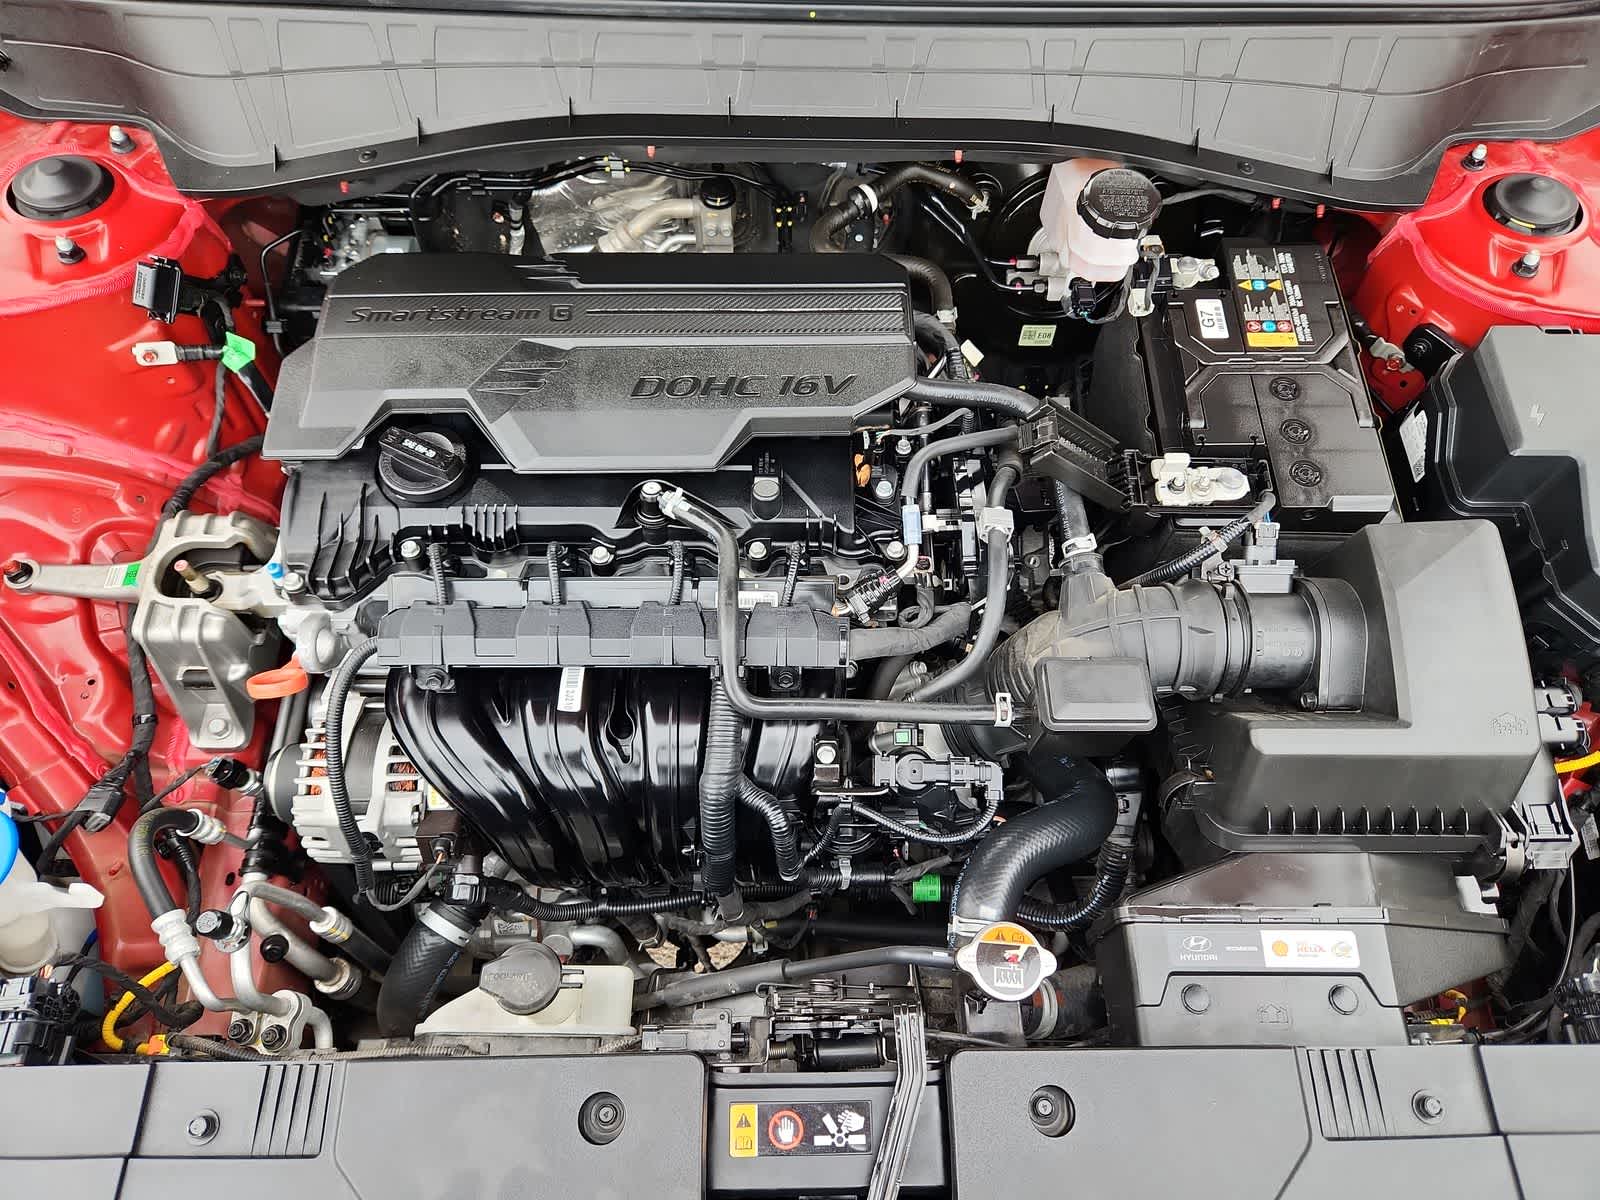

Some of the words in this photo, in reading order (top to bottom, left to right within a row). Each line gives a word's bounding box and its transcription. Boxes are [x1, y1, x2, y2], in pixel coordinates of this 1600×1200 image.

[345, 306, 542, 323] Smartstream
[551, 304, 573, 322] G
[1200, 310, 1216, 328] G7
[630, 374, 768, 398] DOHC
[778, 374, 857, 398] 16V
[401, 438, 418, 450] SAE
[1179, 953, 1218, 962] HYUNDAI
